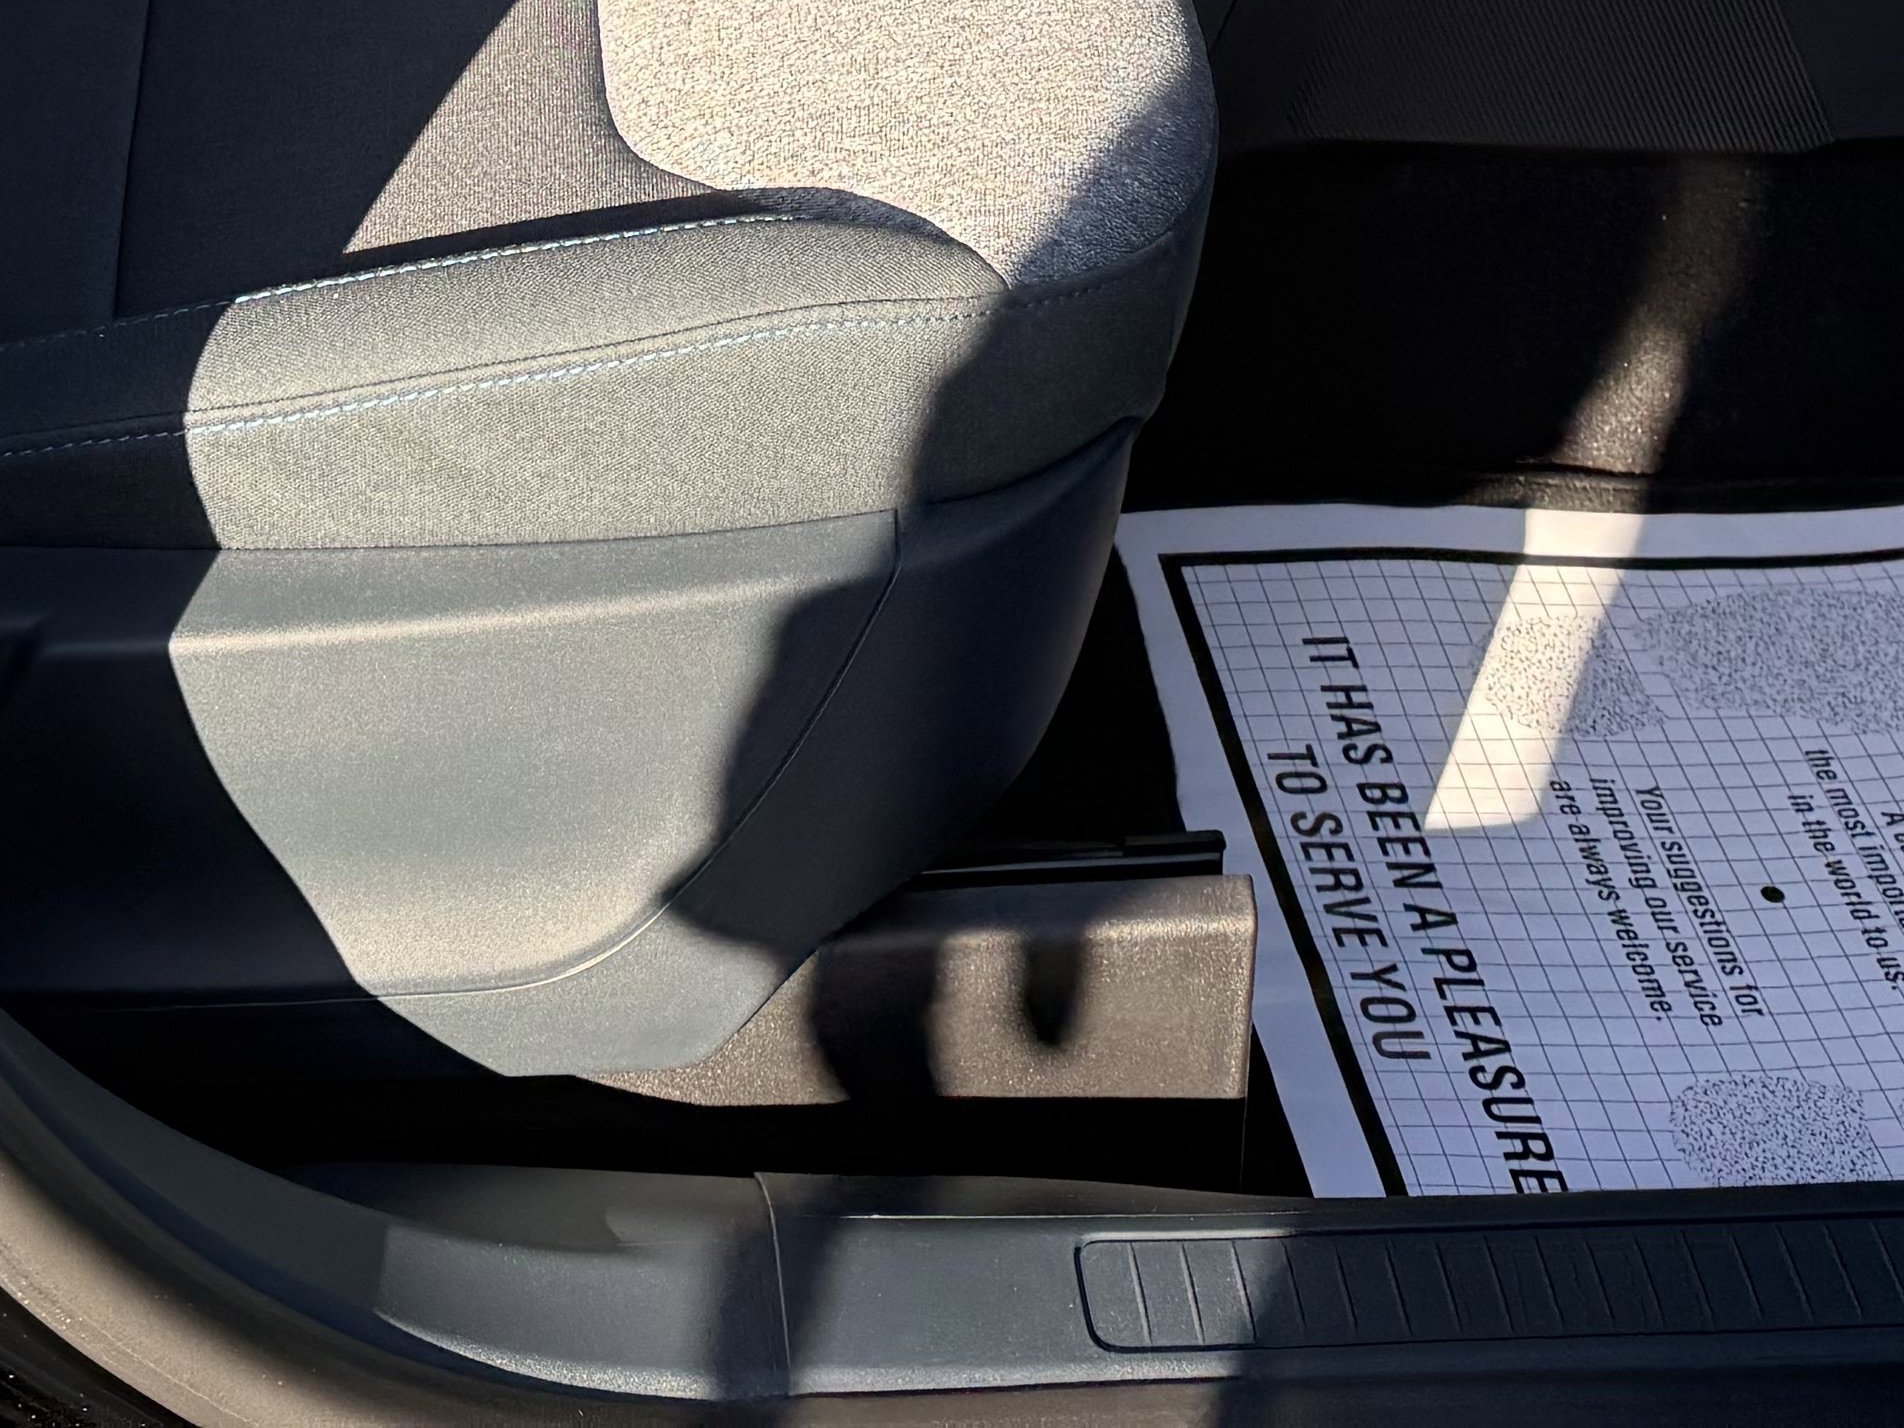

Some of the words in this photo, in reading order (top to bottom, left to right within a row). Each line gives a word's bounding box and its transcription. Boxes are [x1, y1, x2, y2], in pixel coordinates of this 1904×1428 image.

[1302, 636, 1360, 669] IT
[1267, 743, 1328, 796] TO
[1320, 684, 1394, 767] HAS
[1358, 781, 1443, 890] BEEN
[1805, 748, 1837, 782] the
[1825, 787, 1876, 840] most
[1290, 811, 1388, 949] SERVE
[1403, 903, 1459, 932] A
[1549, 779, 1582, 816] are
[1568, 823, 1621, 902] always
[1607, 908, 1673, 1022] welcome.
[1589, 777, 1658, 890] improving
[1645, 897, 1680, 935] our
[1666, 940, 1723, 1028] service
[1635, 785, 1675, 835] Your
[1661, 840, 1744, 977] suggestions
[1729, 983, 1765, 1017] for
[1787, 794, 1814, 813] in
[1802, 820, 1836, 854] the
[1824, 859, 1881, 921] world
[1861, 927, 1889, 949] to
[1350, 964, 1432, 1061] YOU
[1421, 946, 1570, 1194] PLEASURE
